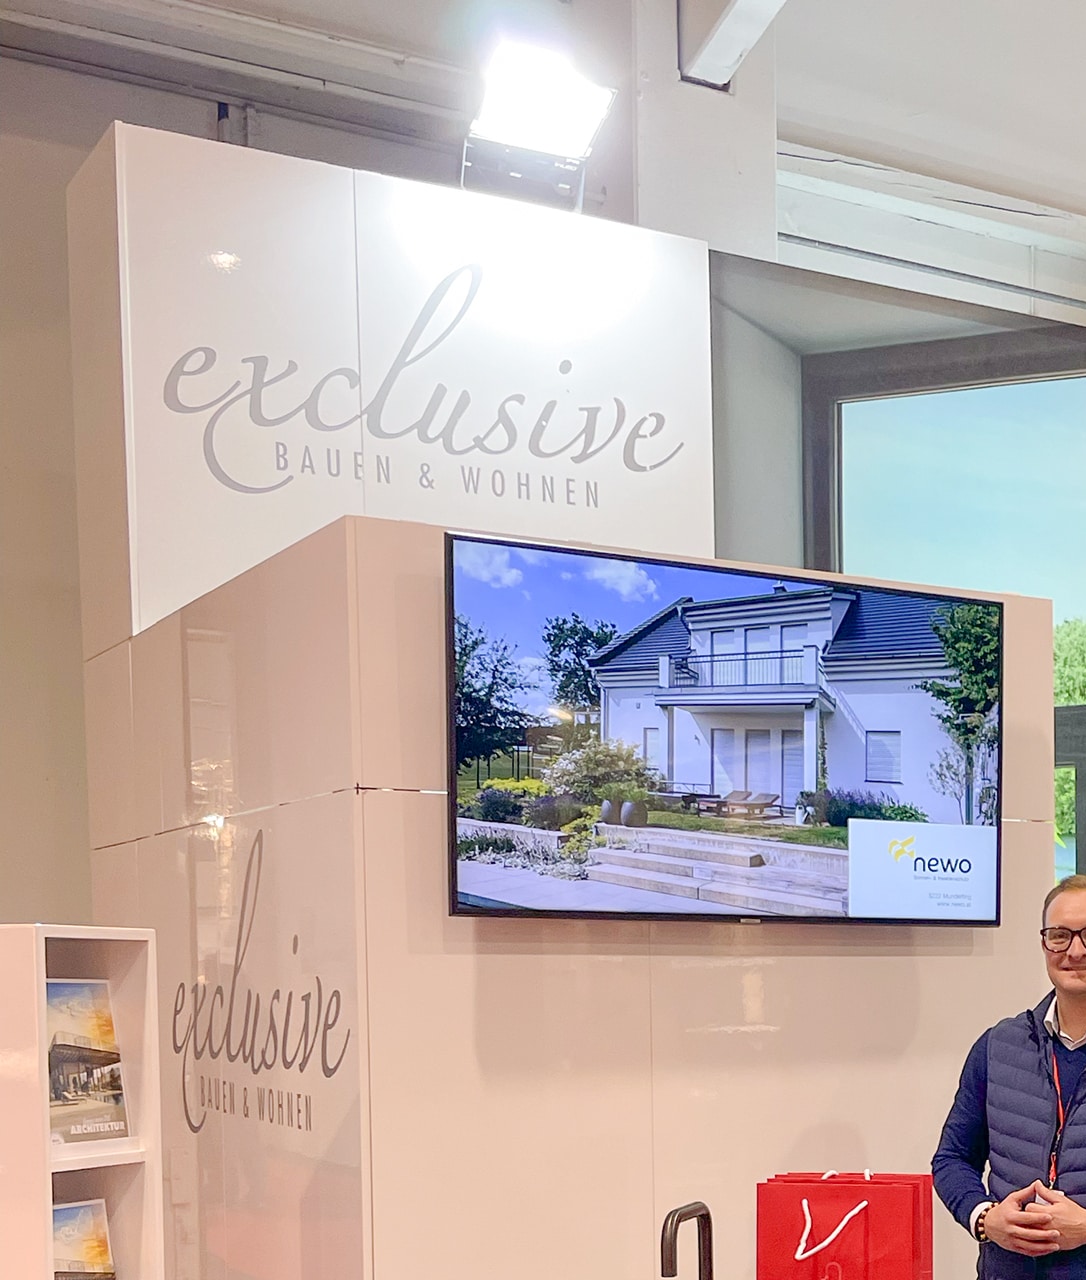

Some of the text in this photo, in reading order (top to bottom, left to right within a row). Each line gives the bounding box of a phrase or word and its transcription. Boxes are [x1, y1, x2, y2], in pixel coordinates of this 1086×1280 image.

[163, 264, 684, 493] exclusive
[275, 441, 600, 509] BAUEN & WOHNEN
[913, 857, 972, 873] newo
[172, 829, 350, 1134] exclusive
[70, 1121, 125, 1135] ARCHITEKTUR
[200, 1075, 312, 1132] BAUEN & WOHNEN
